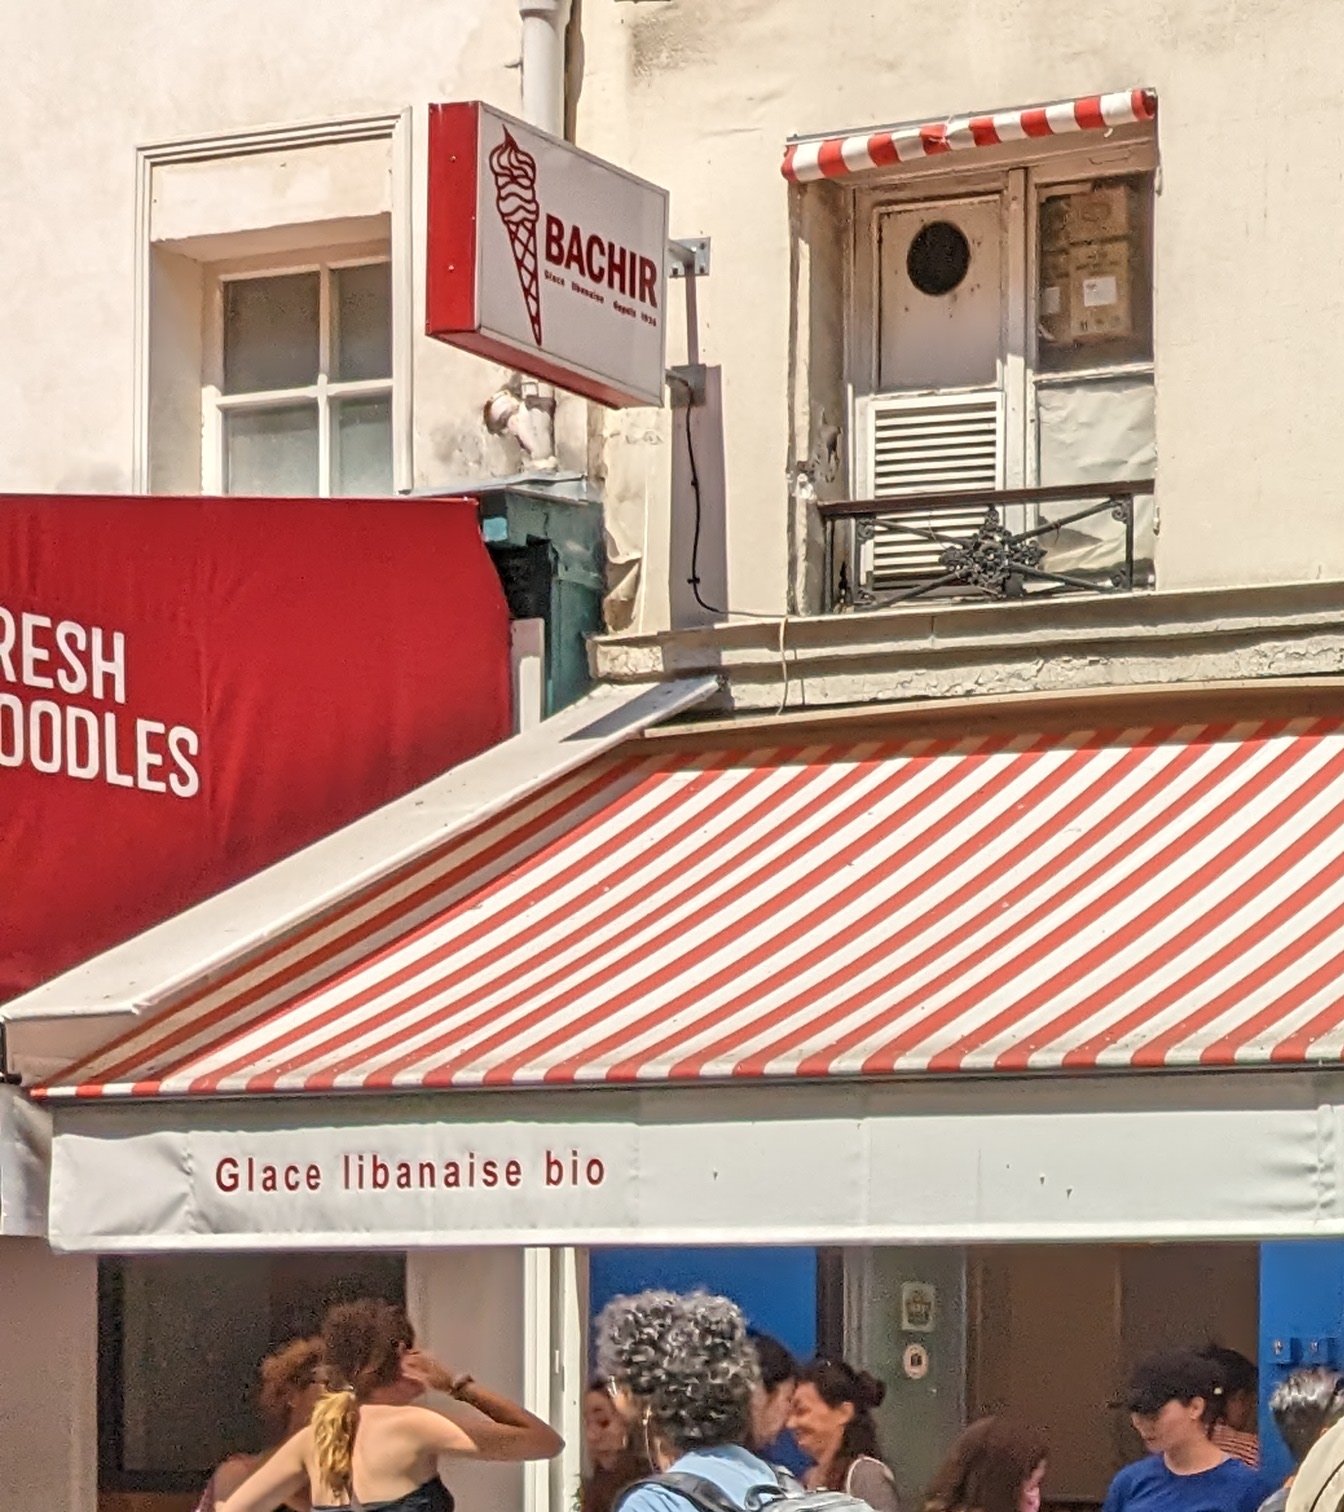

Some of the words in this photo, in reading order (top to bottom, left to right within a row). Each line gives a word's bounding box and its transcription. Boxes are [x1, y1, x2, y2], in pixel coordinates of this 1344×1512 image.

[545, 213, 658, 309] BACHIR
[215, 1157, 322, 1192] Glace
[343, 1152, 523, 1191] libanaise
[545, 1150, 606, 1187] bio
